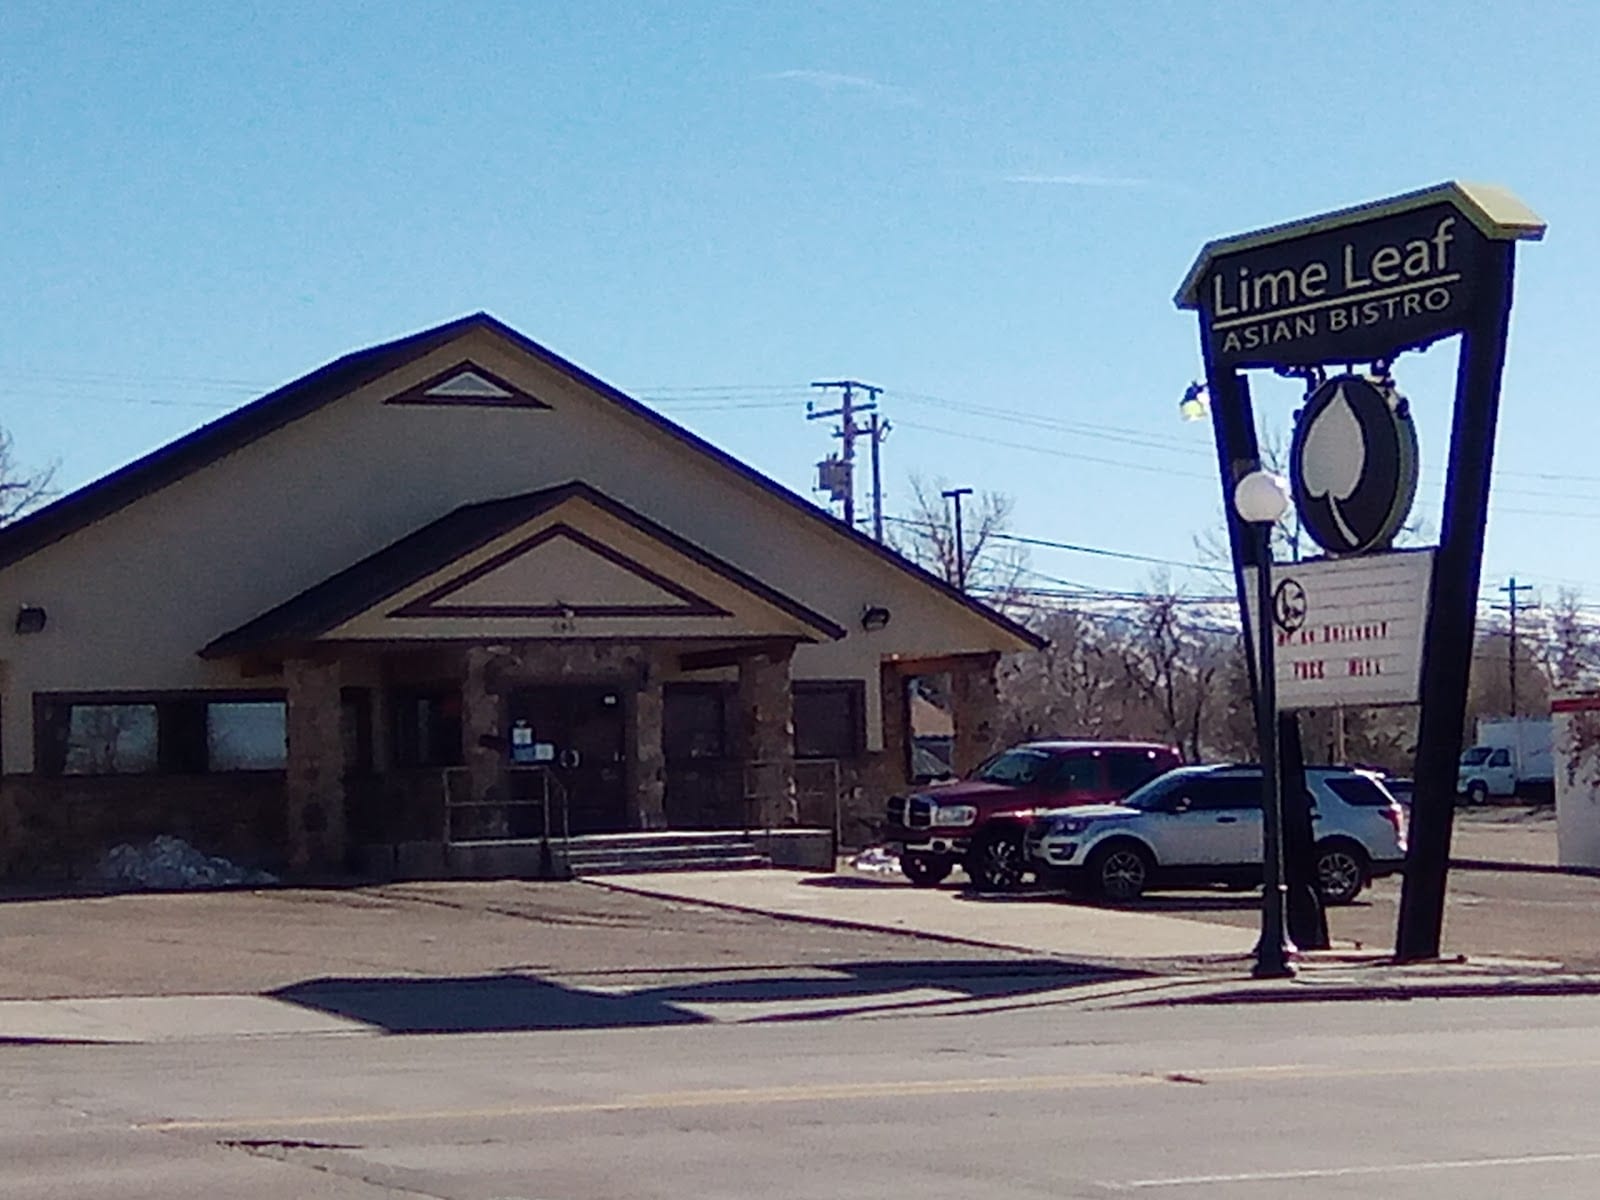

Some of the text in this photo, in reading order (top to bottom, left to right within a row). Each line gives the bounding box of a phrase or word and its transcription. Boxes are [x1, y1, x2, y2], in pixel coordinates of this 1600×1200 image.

[1213, 218, 1456, 317] Lime Leaf
[1222, 288, 1450, 352] ASIAN BISTRO
